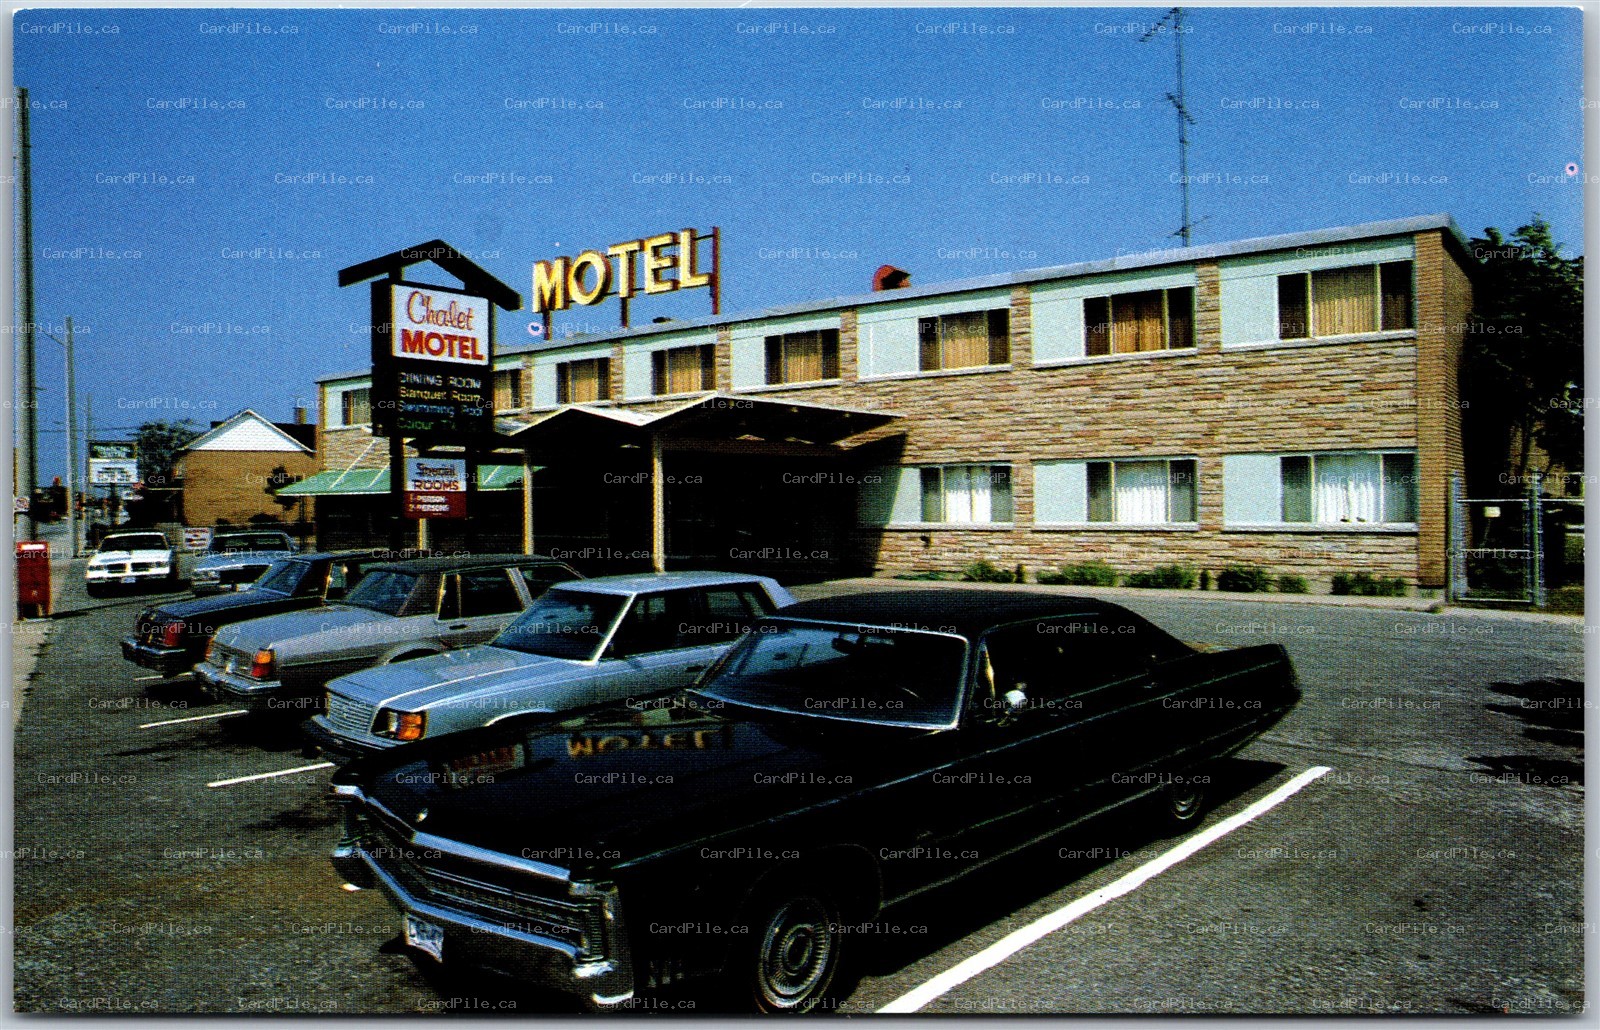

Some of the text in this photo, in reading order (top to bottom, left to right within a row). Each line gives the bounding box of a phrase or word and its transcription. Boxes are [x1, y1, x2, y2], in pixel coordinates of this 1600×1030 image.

[532, 228, 712, 313] MOTEL
[407, 290, 476, 331] Chalet
[401, 328, 484, 360] MOTEL
[400, 371, 482, 389] DINING ROOM
[412, 479, 460, 491] ROOMS
